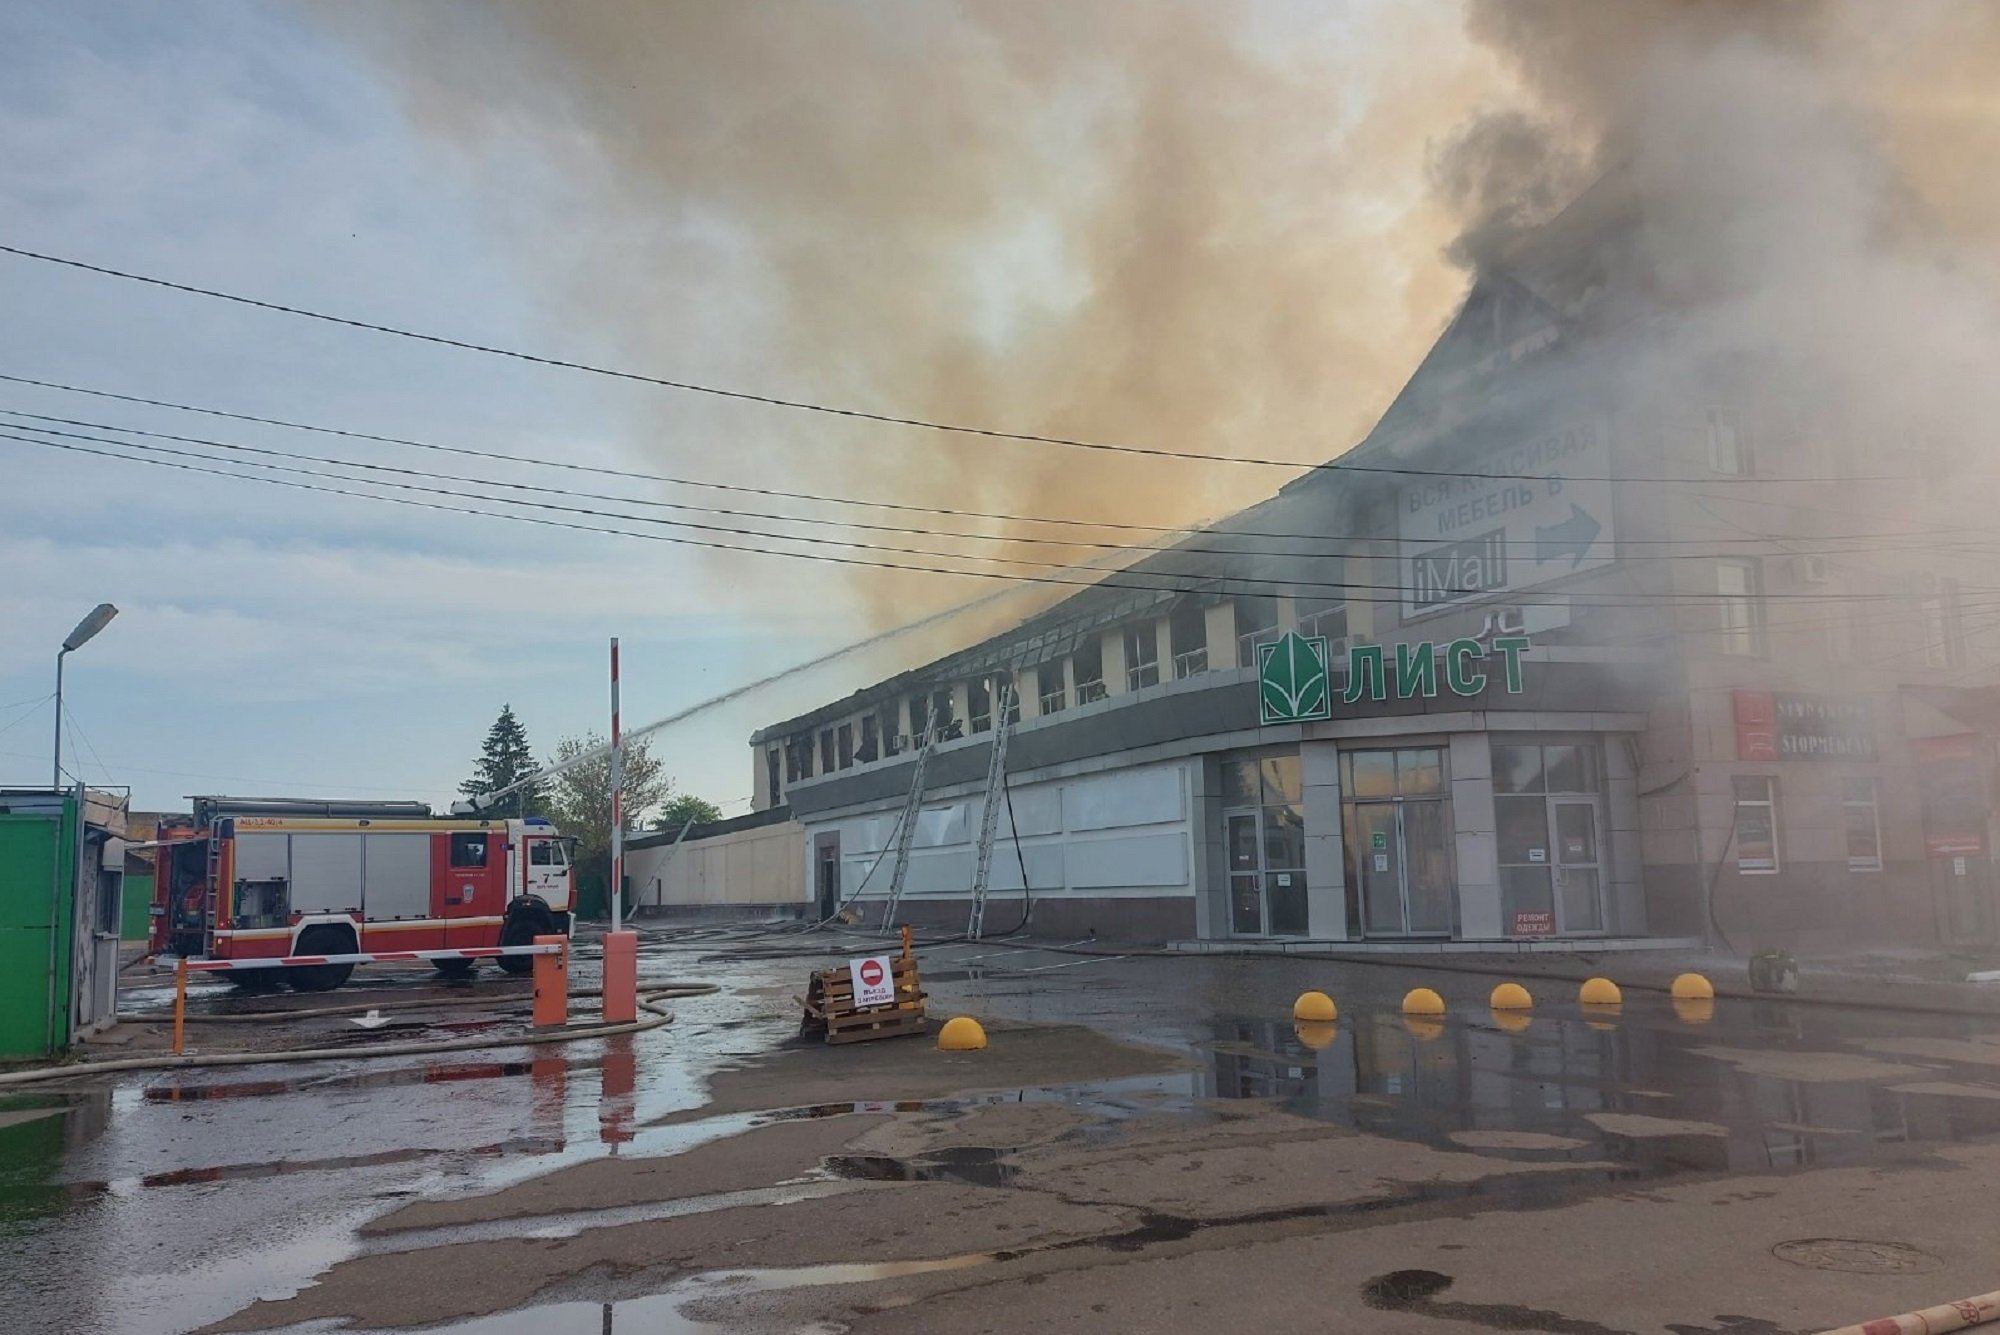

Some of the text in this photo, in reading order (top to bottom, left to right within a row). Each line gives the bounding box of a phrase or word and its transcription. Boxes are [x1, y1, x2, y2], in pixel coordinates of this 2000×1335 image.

[1408, 479, 1450, 513] ВСЯ
[1437, 470, 1563, 534] МЕБЕЛЬ В
[1417, 534, 1502, 602] iMall
[1344, 637, 1530, 704] ЛИСТ
[543, 873, 550, 884] 7
[1517, 913, 1549, 922] РЕМОНТ
